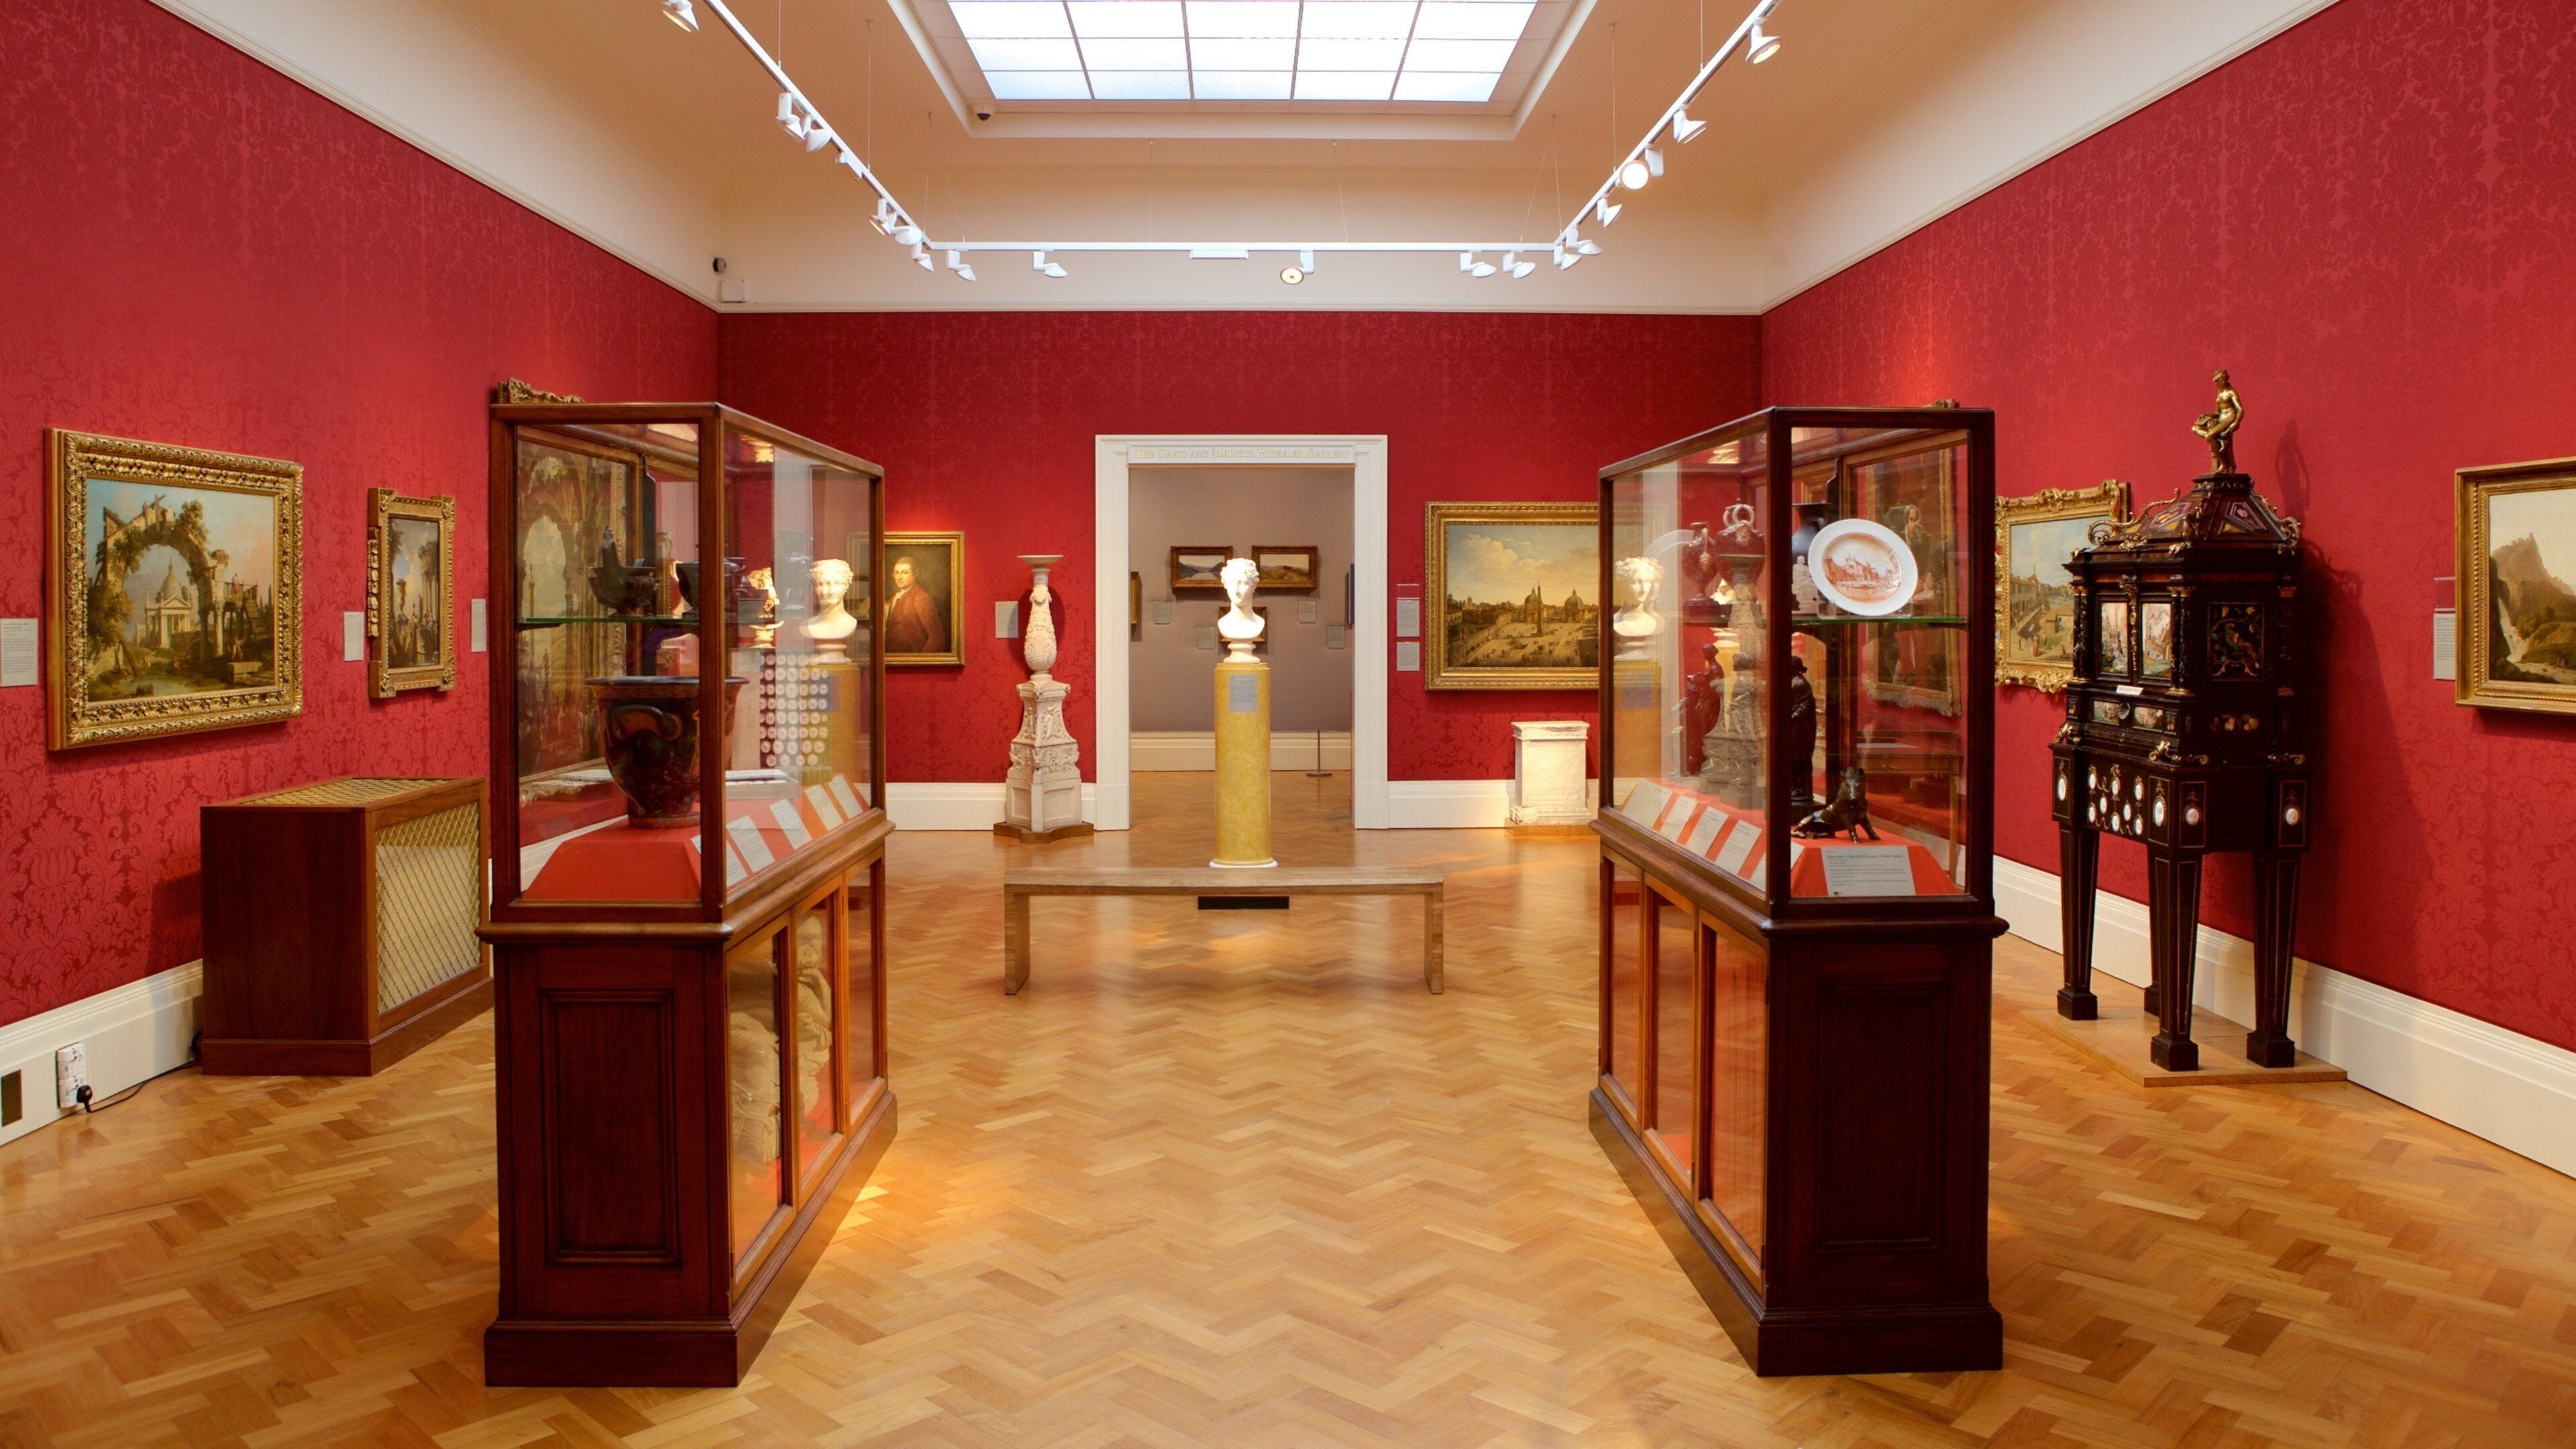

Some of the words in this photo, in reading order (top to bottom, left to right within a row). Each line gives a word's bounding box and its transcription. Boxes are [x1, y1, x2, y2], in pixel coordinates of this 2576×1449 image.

[1134, 447, 1154, 458] THE
[1190, 450, 1209, 458] AND
[1306, 447, 1350, 458] GALLERY
